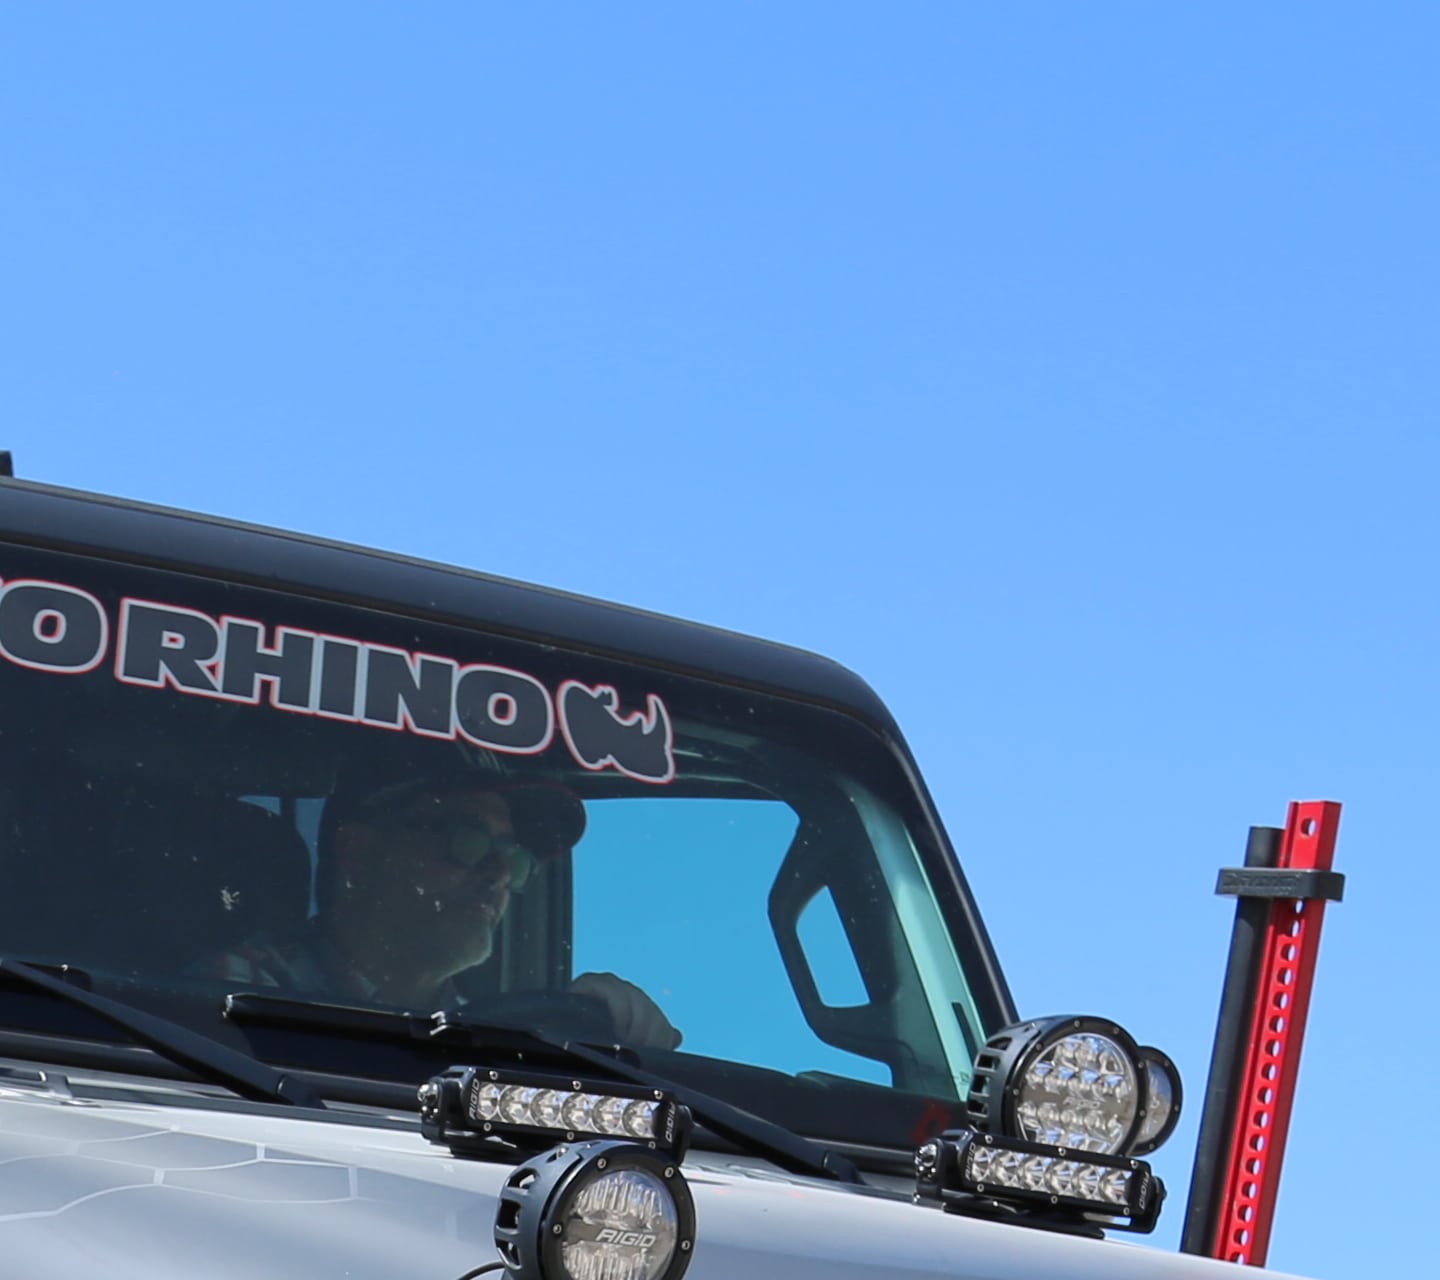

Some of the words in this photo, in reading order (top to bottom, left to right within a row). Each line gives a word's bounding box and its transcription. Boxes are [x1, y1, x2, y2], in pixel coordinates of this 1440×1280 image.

[115, 598, 554, 754] RHINO
[469, 1079, 480, 1121] RIGID
[595, 1229, 657, 1248] RIGID
